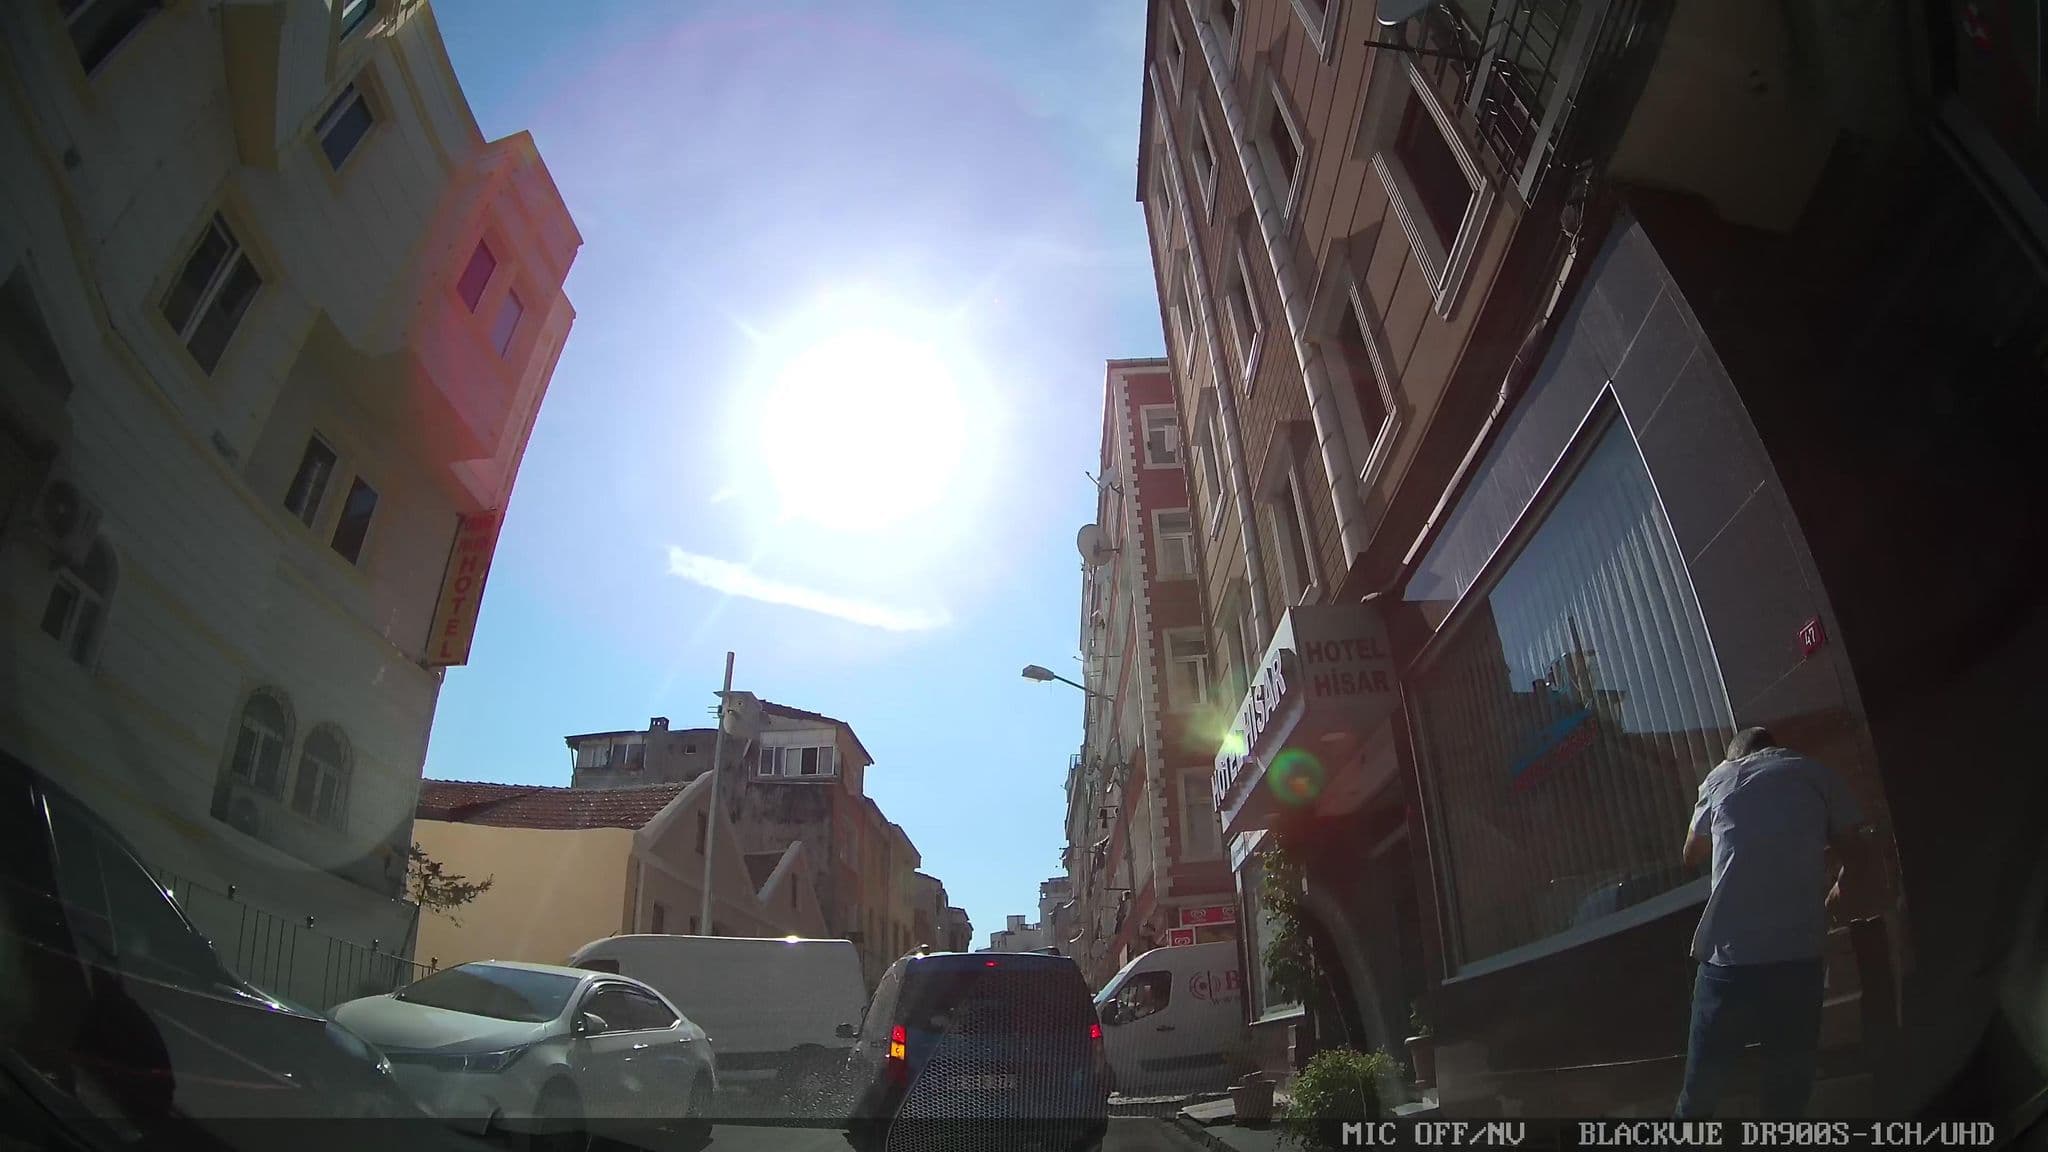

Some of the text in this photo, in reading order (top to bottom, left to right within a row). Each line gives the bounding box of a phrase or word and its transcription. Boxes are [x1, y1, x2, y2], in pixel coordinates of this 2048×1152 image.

[440, 555, 478, 659] HOTEL
[1804, 626, 1816, 646] 47
[1305, 637, 1386, 664] HOTEL
[1314, 668, 1390, 697] HİSAR
